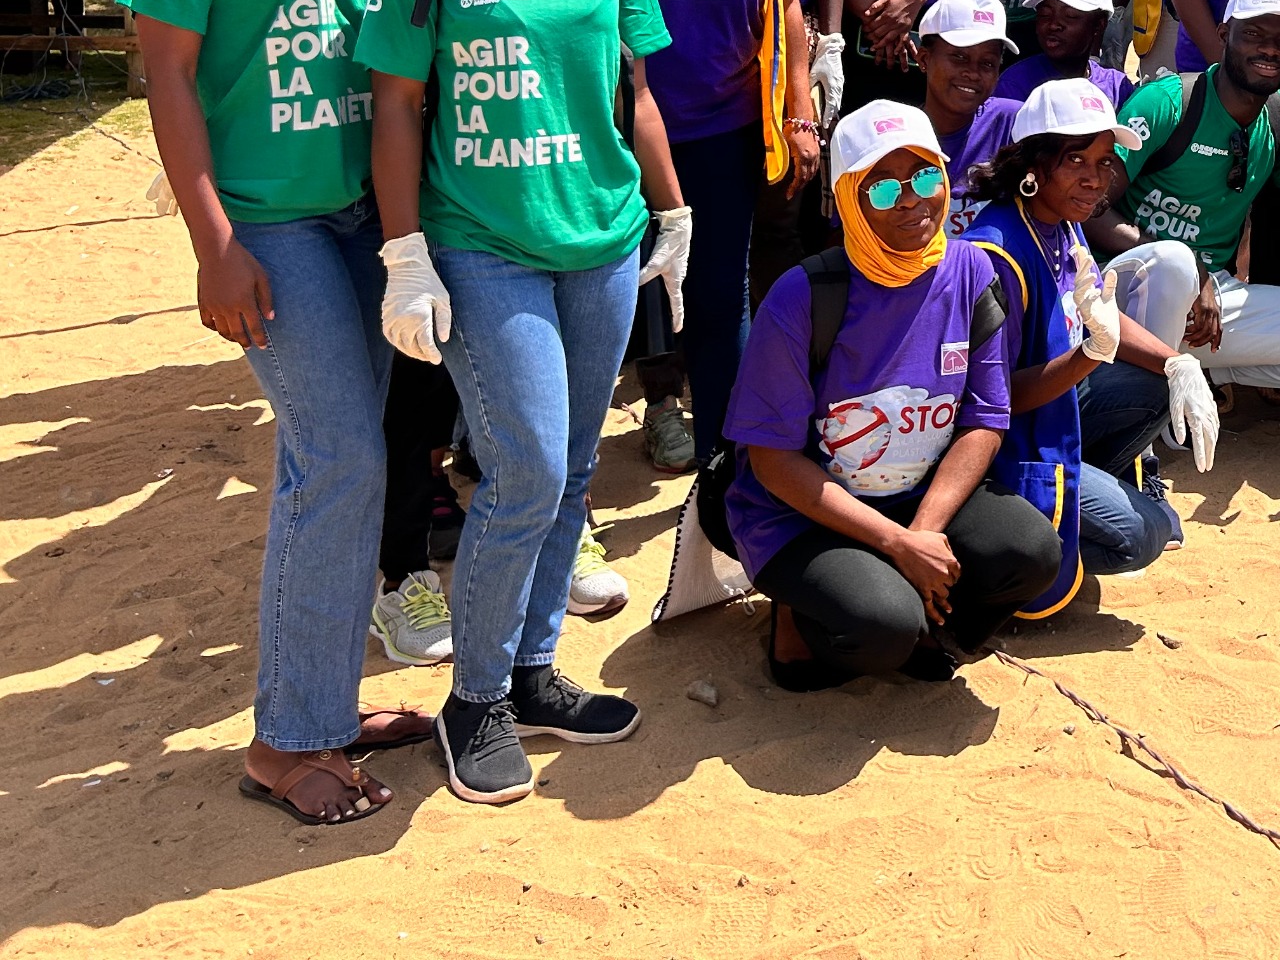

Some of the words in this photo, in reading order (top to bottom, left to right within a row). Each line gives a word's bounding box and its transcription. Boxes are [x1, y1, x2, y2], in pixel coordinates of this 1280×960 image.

[266, 29, 348, 65] POUR
[452, 36, 531, 67] AGIR
[269, 67, 313, 98] LA
[454, 70, 542, 100] POUR
[271, 88, 373, 132] PLANÈT
[456, 105, 489, 134] LA
[455, 129, 582, 167] PLANÈTE
[1144, 189, 1201, 222] AGIR
[950, 211, 976, 235] ST
[1136, 203, 1200, 241] POUR
[898, 402, 956, 434] STO
